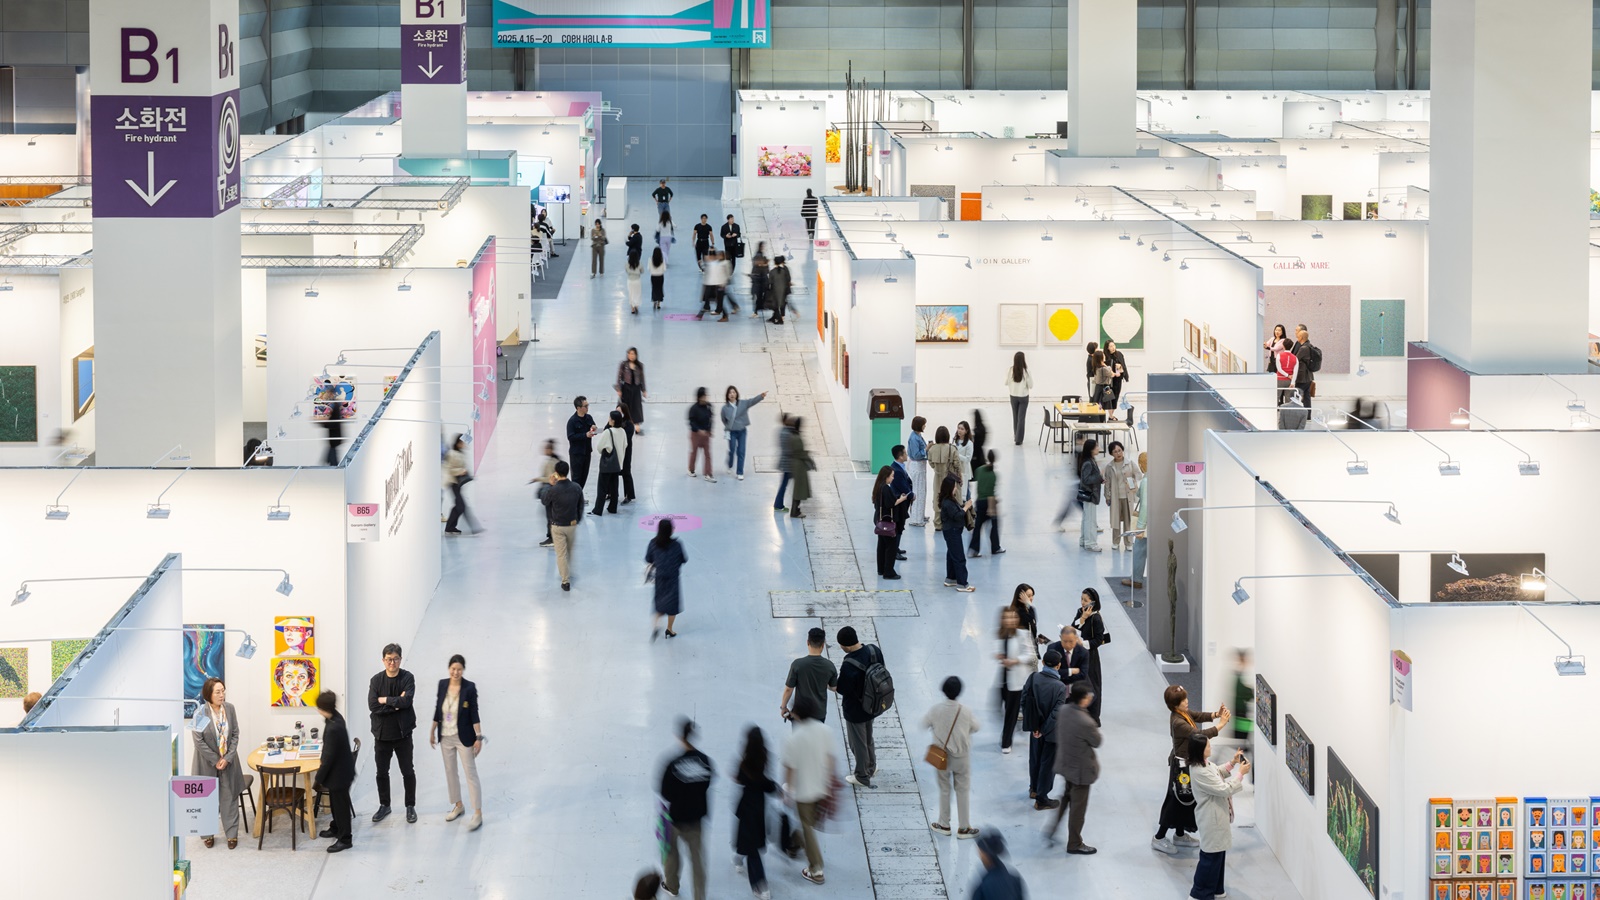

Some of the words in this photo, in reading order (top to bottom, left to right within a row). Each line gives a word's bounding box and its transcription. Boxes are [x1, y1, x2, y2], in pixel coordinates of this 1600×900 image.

[413, 29, 448, 42] 소화전
[121, 27, 179, 84] B1
[218, 23, 234, 79] B1
[115, 107, 187, 132] 소화전
[125, 134, 143, 142] Fire
[144, 134, 178, 144] hydrant
[356, 506, 370, 514] B65
[184, 783, 203, 794] B64
